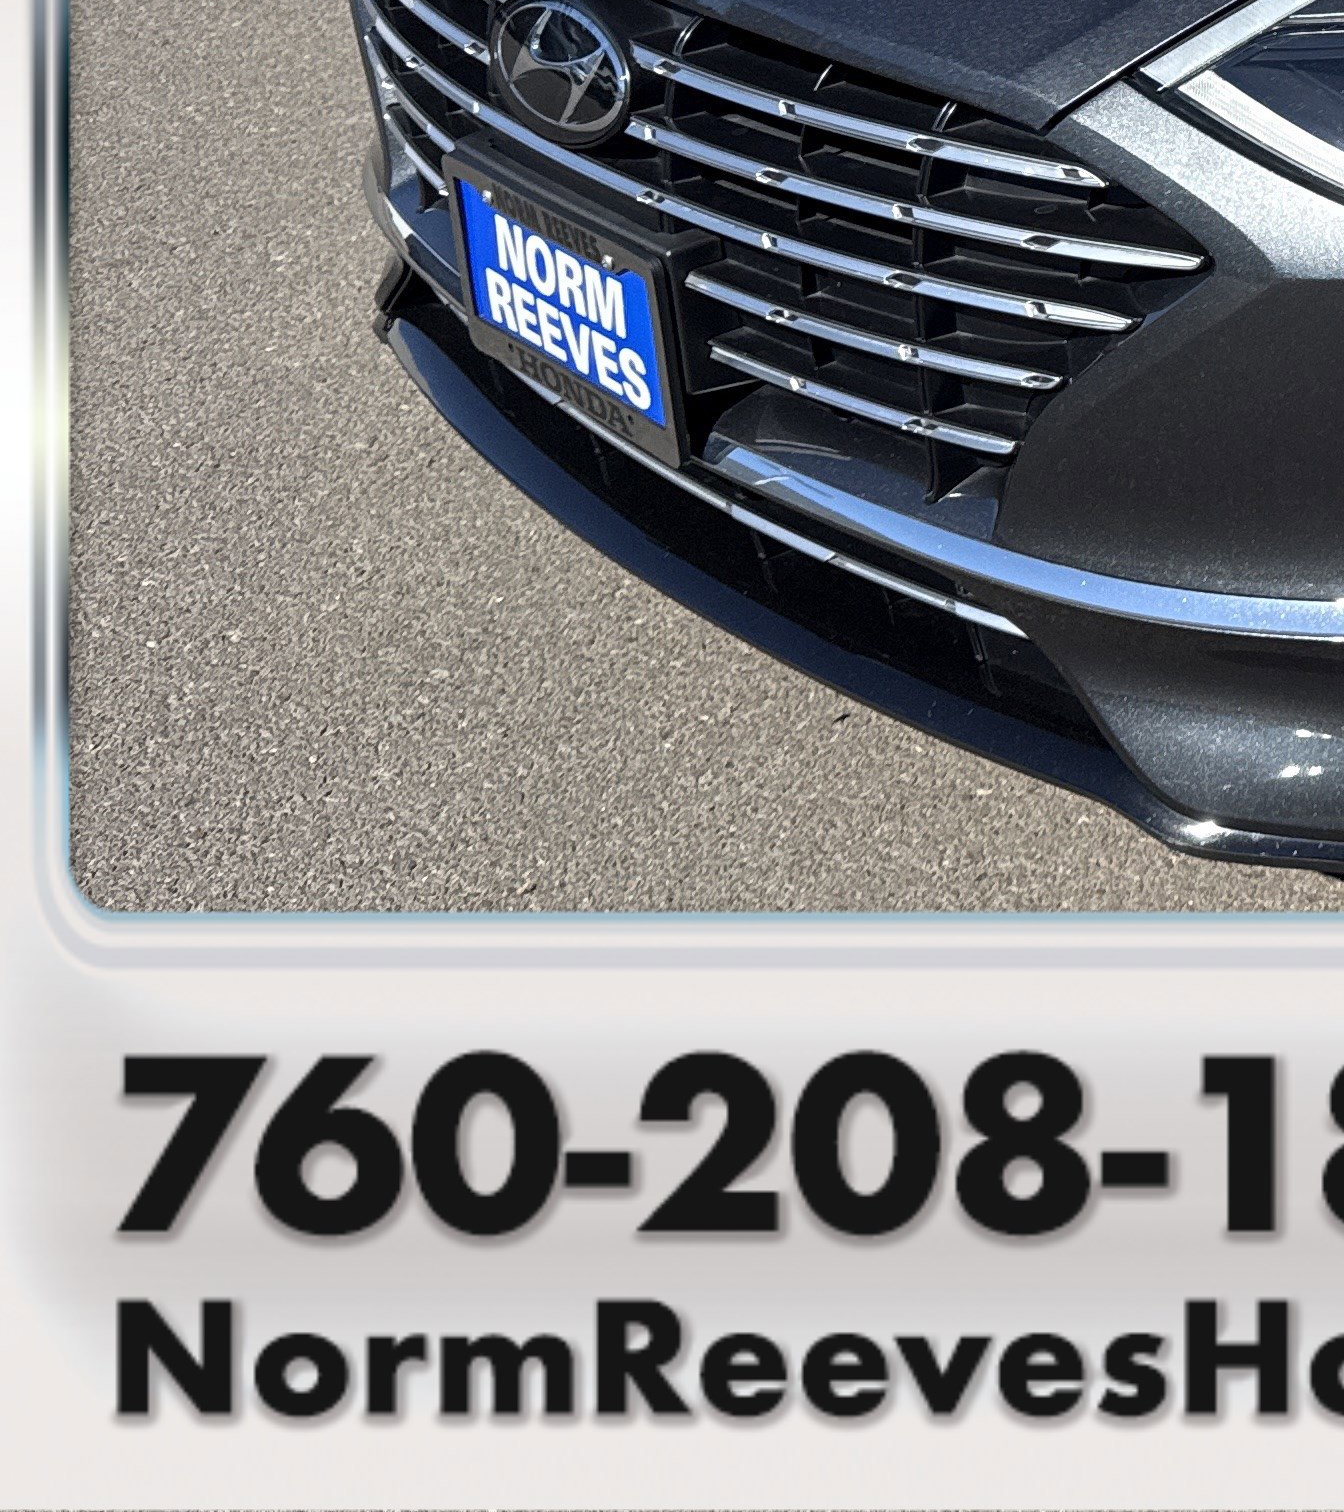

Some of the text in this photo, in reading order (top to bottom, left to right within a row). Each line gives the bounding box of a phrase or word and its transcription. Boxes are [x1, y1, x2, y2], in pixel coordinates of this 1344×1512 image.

[485, 266, 652, 411] REEVES
[493, 212, 628, 341] NORM
[515, 345, 634, 436] HONDA
